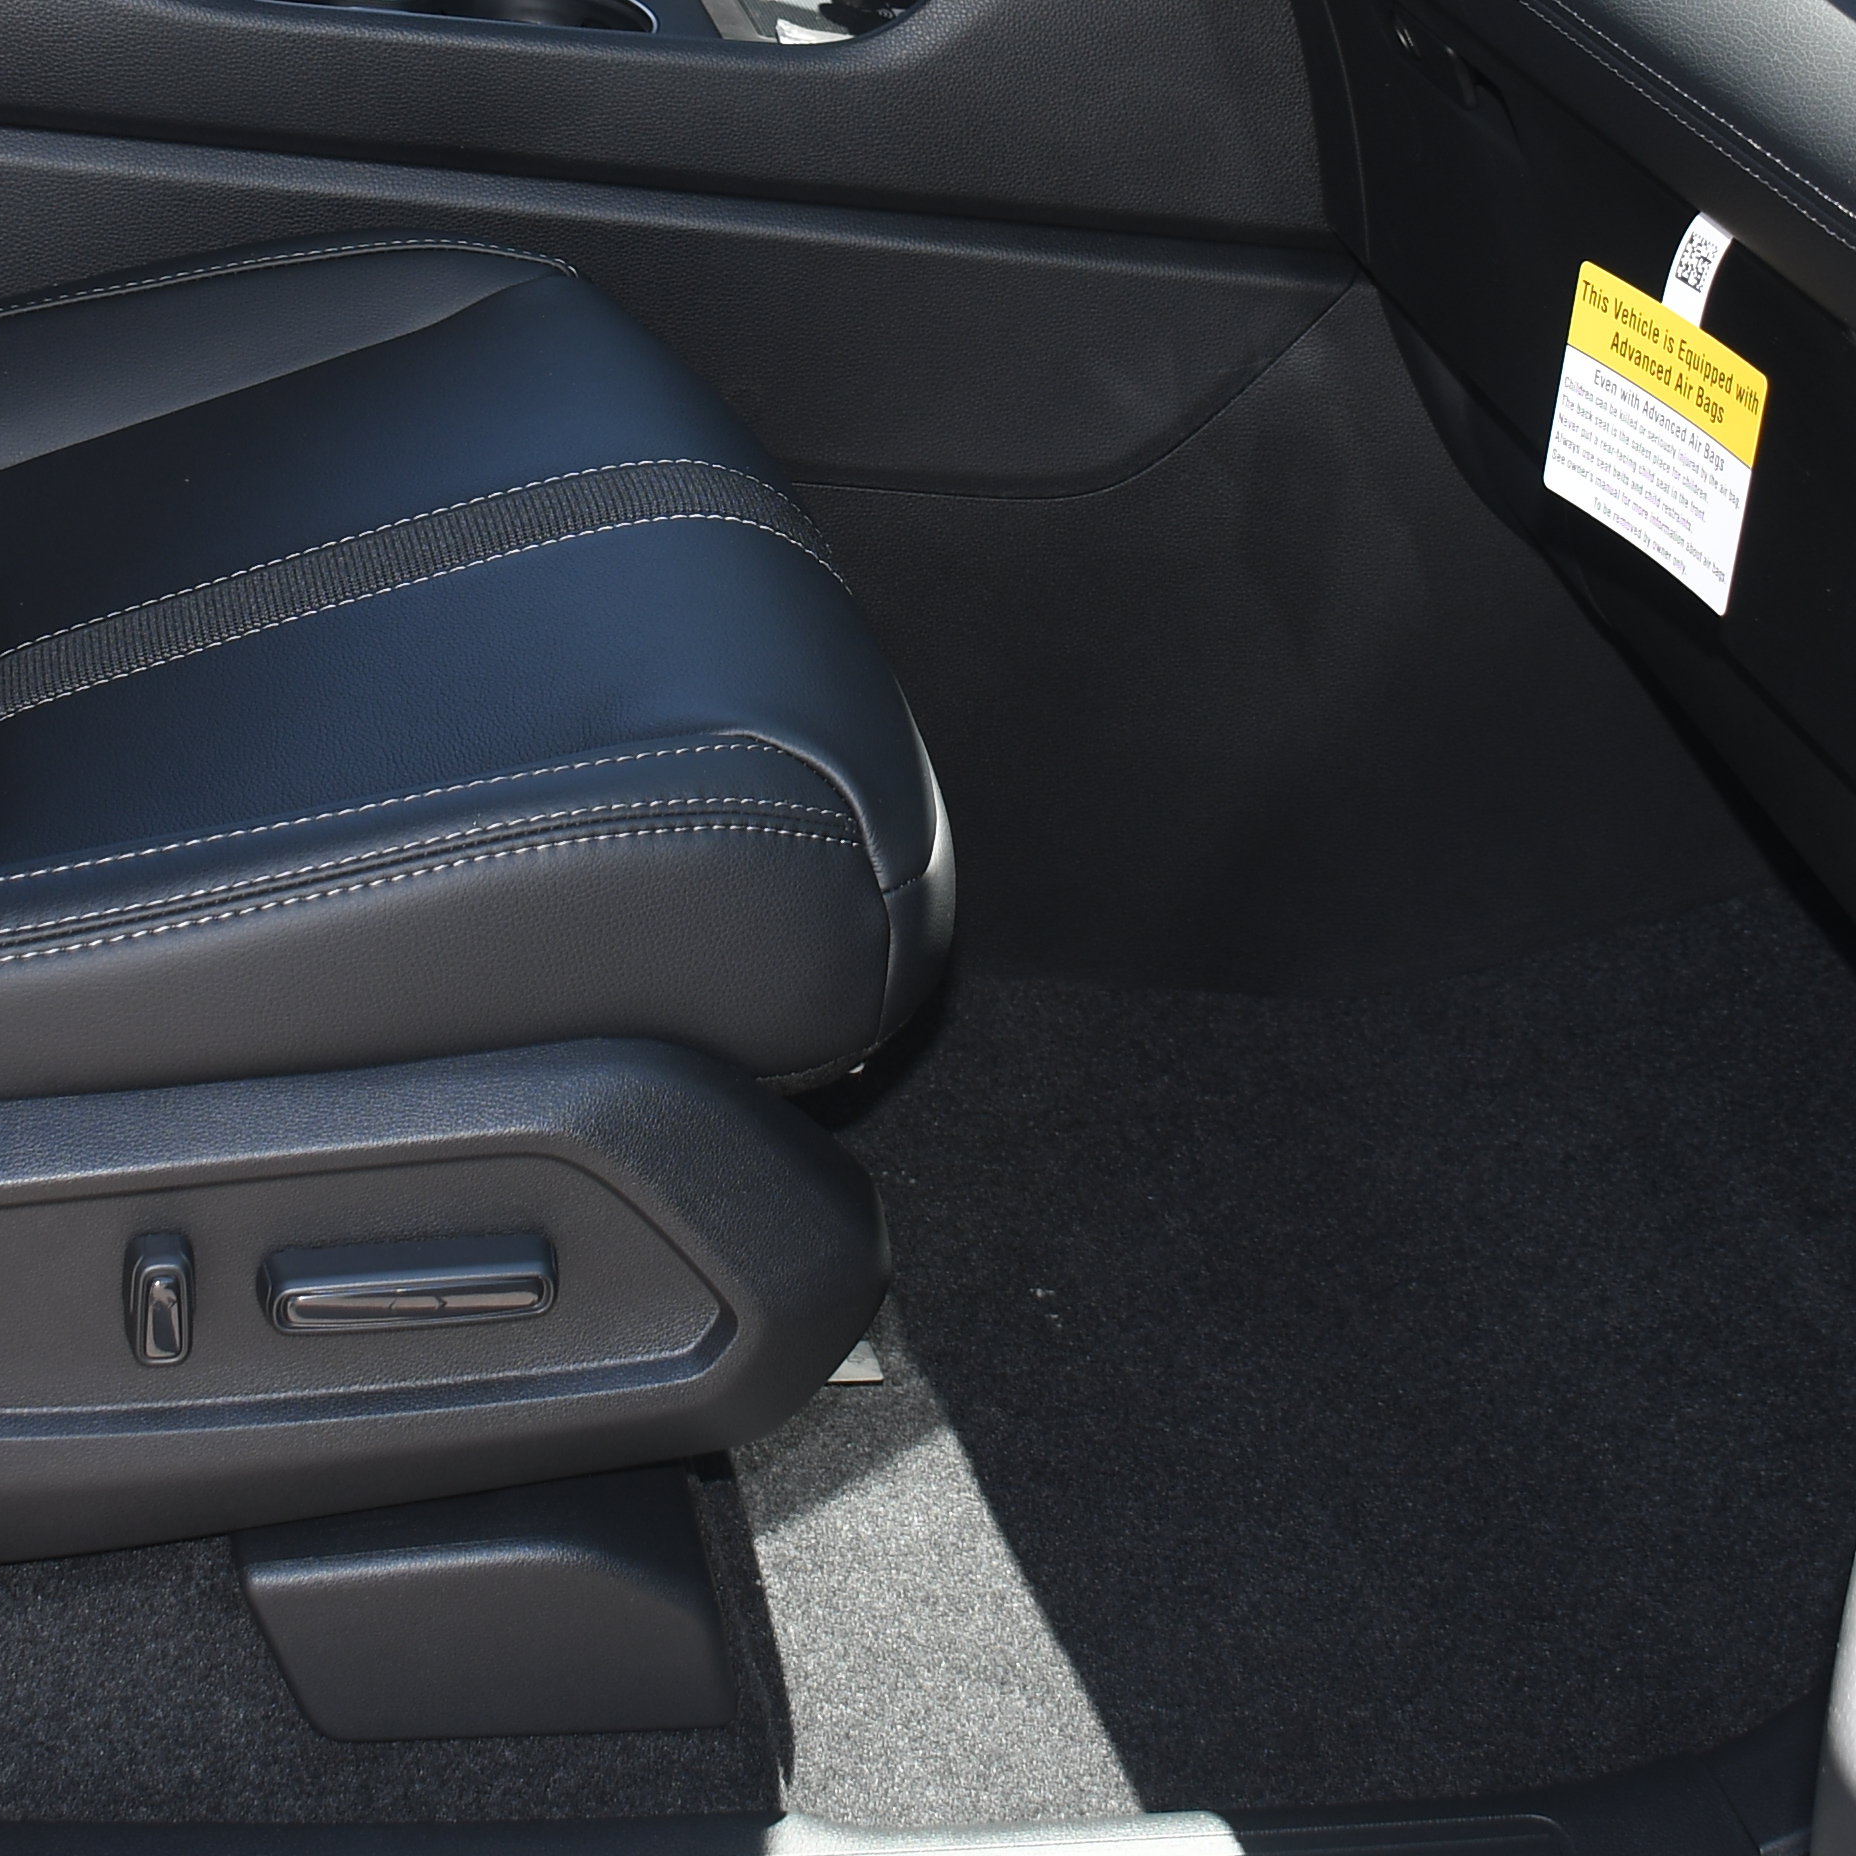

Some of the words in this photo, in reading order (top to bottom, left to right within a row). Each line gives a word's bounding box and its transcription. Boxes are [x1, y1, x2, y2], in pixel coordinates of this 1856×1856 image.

[1583, 280, 1609, 313] This
[1614, 298, 1660, 344] Vehicle
[1663, 329, 1675, 354] is
[1678, 339, 1733, 395] Equipped
[1736, 384, 1759, 416] with
[1610, 331, 1672, 386] Advanced
[1674, 373, 1693, 400] Air
[1696, 386, 1724, 424] Bags
[1594, 369, 1617, 396] Even
[1621, 388, 1640, 411] with
[1642, 401, 1687, 442] Advanced
[1688, 433, 1702, 453] Air
[1704, 443, 1725, 472] Bags
